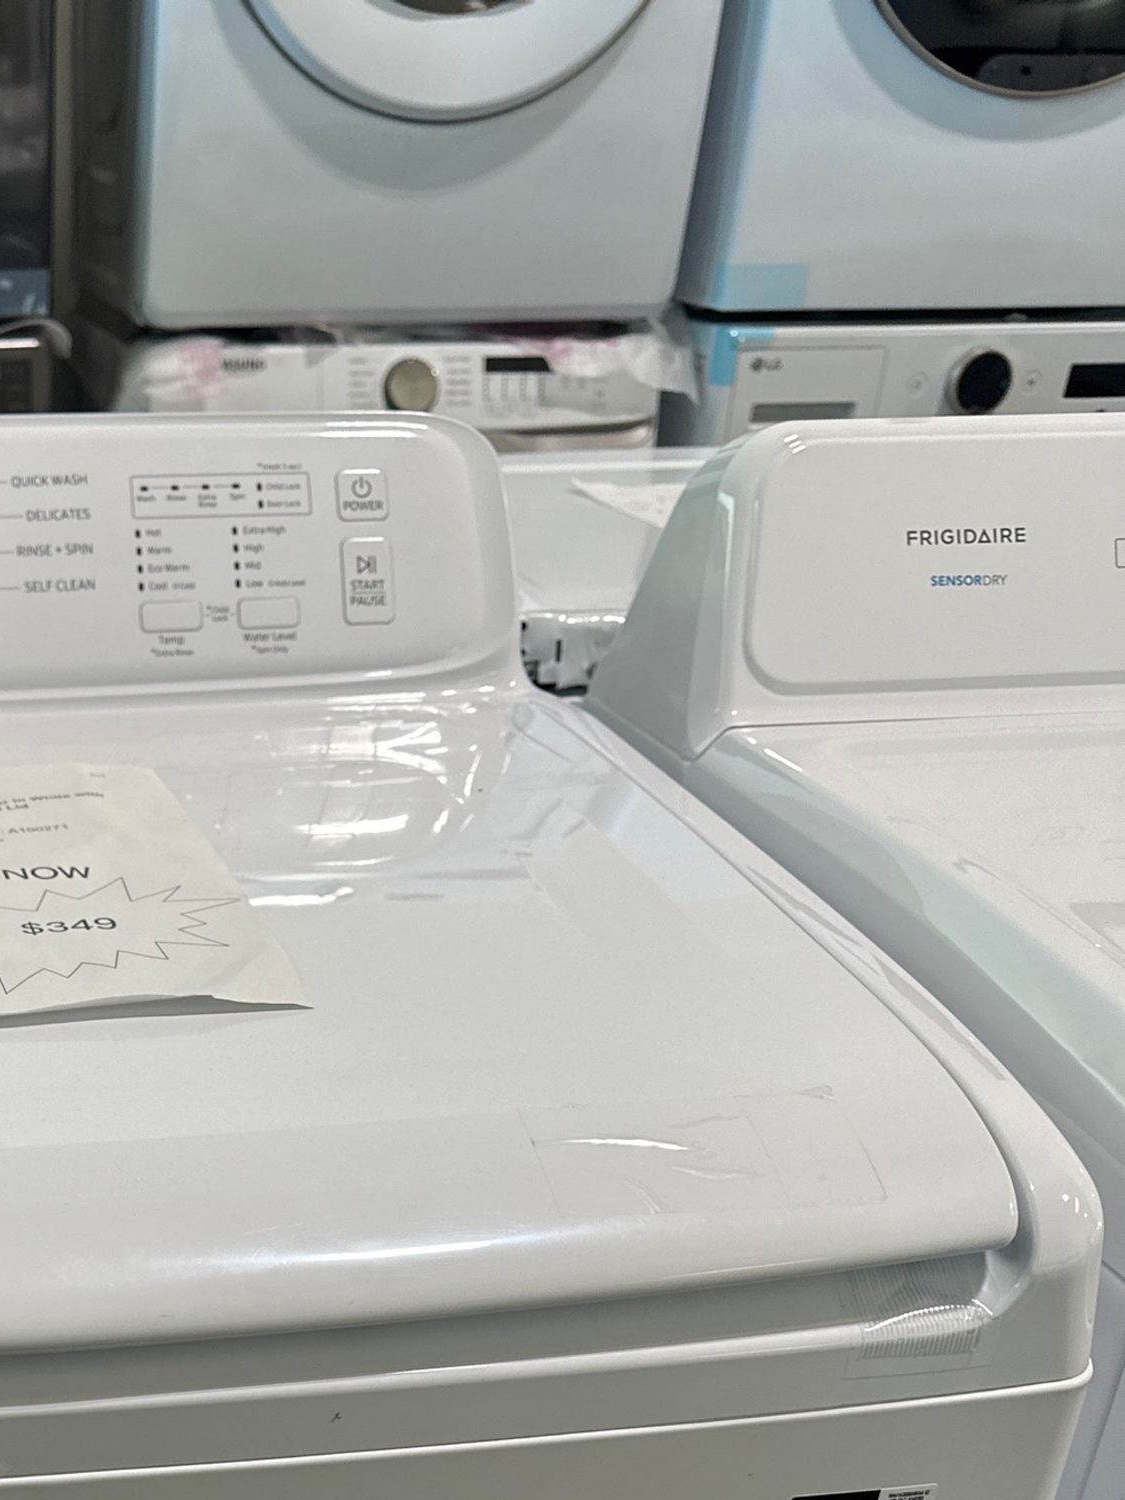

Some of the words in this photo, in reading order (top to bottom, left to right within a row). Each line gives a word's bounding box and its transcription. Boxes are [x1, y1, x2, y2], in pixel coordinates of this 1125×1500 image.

[10, 475, 49, 488] QUICK
[52, 473, 88, 486] WASH
[343, 500, 383, 511] POWER
[25, 507, 91, 521] DELICATES
[905, 527, 1027, 546] FRIGIDAIRE
[16, 544, 52, 557] RINSE
[64, 543, 93, 556] SPIN
[23, 579, 53, 593] SELF
[55, 578, 96, 592] CLEAN
[349, 579, 384, 590] START
[930, 574, 1008, 587] SENSORDRY
[349, 595, 386, 606] PAUSE
[243, 632, 270, 642] Water
[1, 866, 90, 880] NOW
[20, 917, 117, 935] $349
